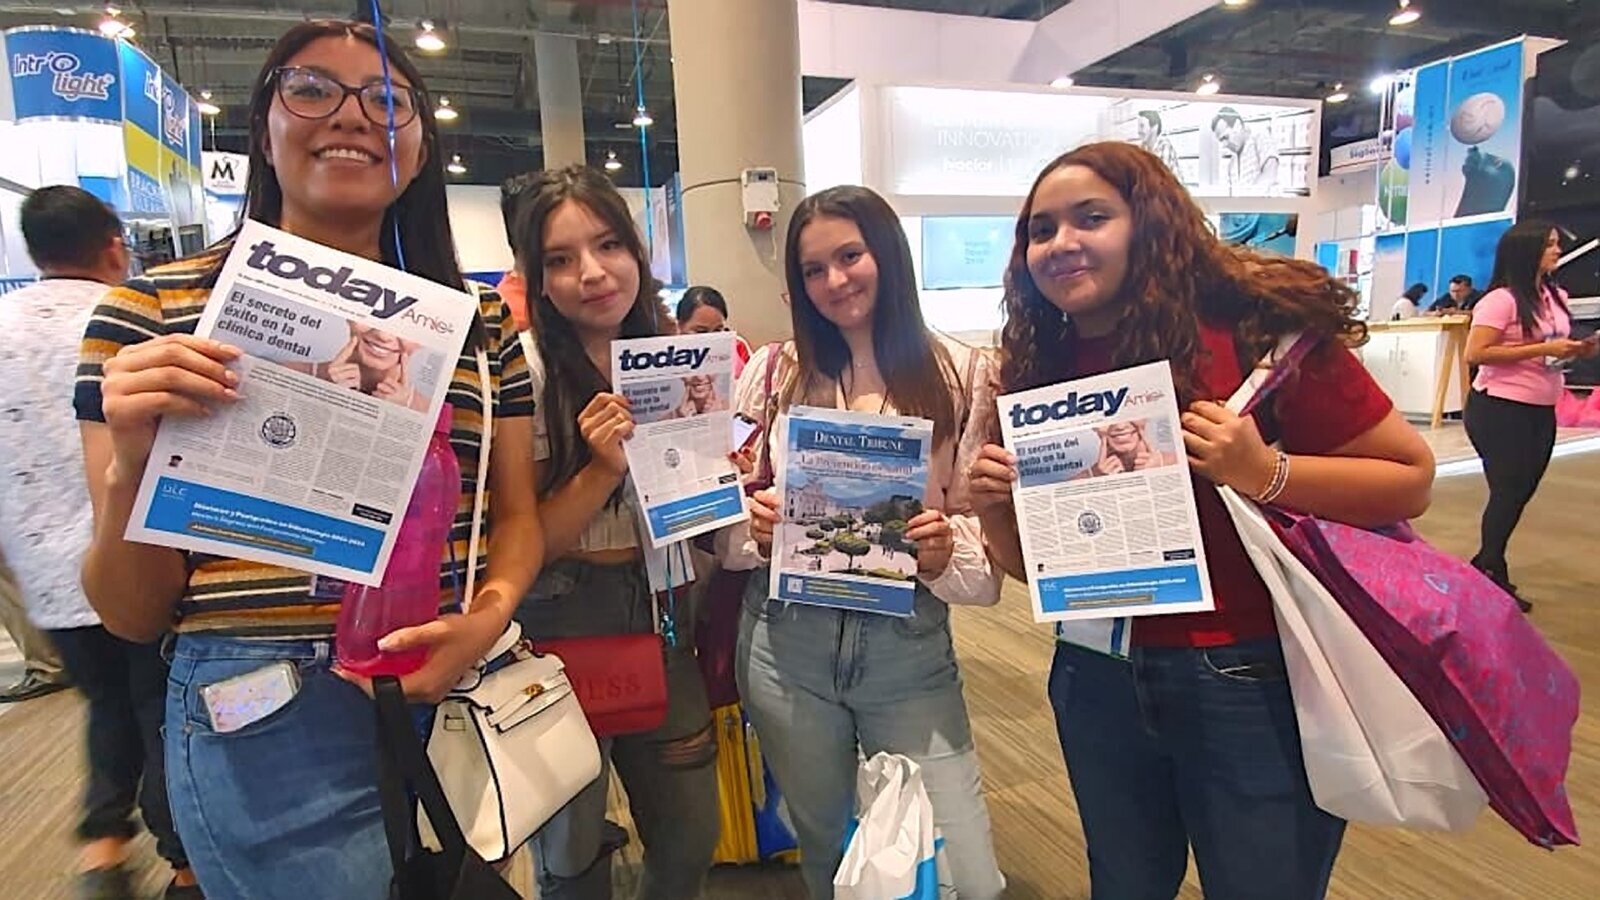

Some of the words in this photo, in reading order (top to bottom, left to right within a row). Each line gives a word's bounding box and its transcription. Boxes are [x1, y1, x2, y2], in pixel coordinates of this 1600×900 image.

[246, 240, 419, 320] today
[224, 304, 258, 324] éxito
[262, 318, 278, 330] en
[281, 322, 295, 337] la
[231, 290, 245, 304] El
[246, 298, 297, 321] secreto
[300, 314, 322, 330] del
[267, 334, 311, 357] dental
[618, 345, 710, 372] today
[1009, 386, 1129, 428] today
[814, 430, 856, 446] DENTAL
[858, 434, 904, 452] TRIBUNE
